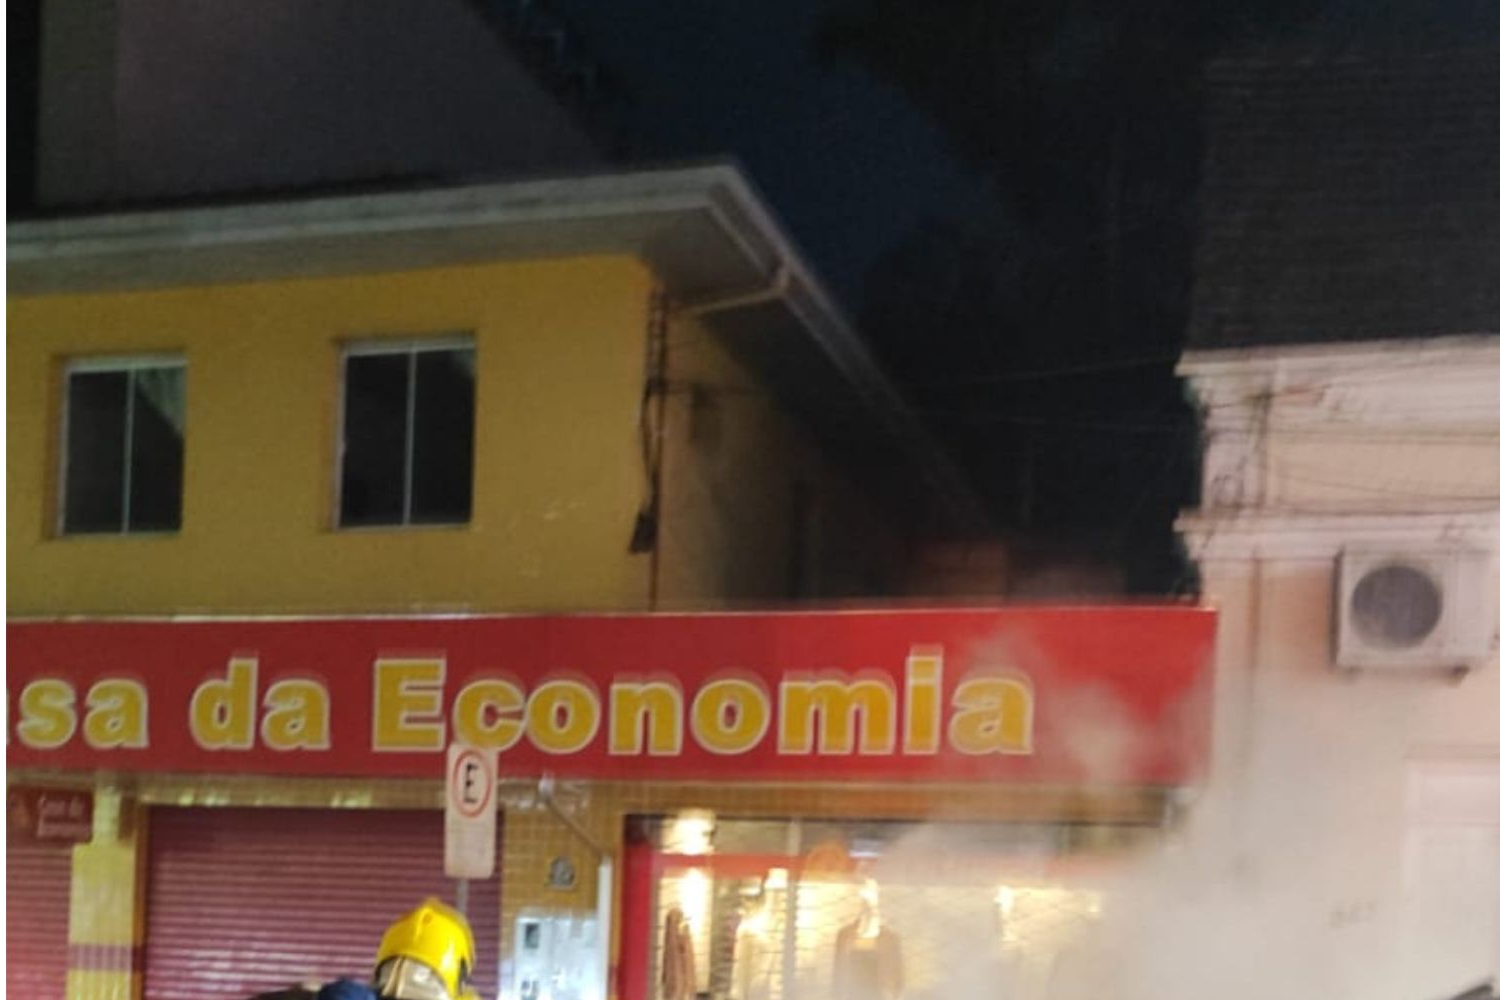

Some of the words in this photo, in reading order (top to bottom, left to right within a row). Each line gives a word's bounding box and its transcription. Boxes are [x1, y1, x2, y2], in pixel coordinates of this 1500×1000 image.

[7, 679, 150, 749] sa
[190, 657, 331, 750] da
[372, 654, 1033, 757] Economia
[463, 762, 480, 804] E
